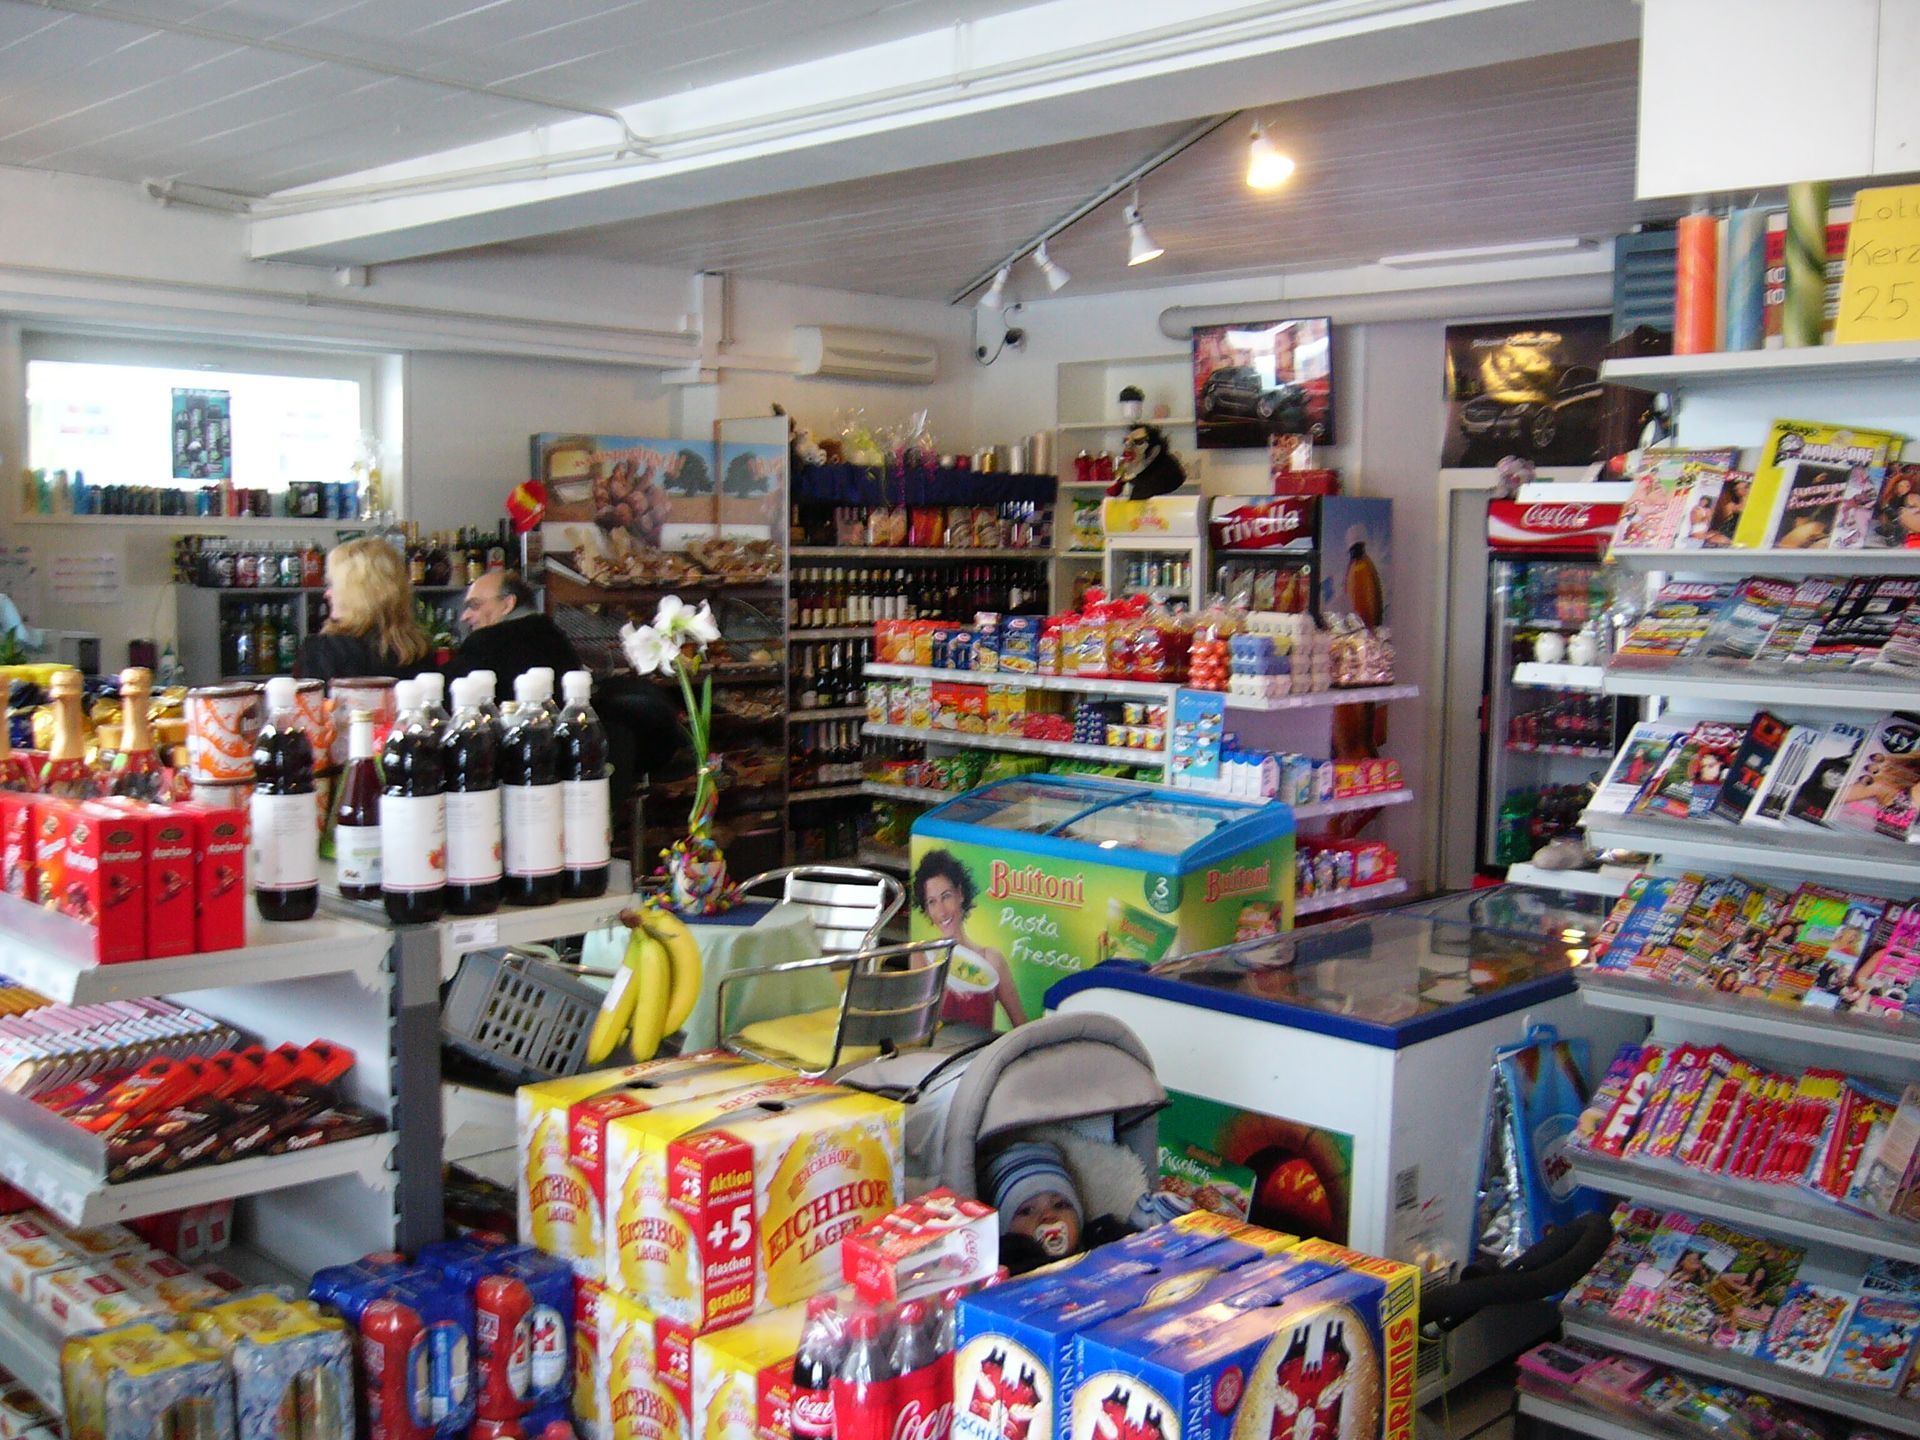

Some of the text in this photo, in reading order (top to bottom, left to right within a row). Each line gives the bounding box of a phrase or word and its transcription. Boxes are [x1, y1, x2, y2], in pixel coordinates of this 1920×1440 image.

[1855, 198, 1920, 223] Lot
[1219, 504, 1301, 548] rivella
[986, 857, 1085, 905] Buitoni
[1153, 876, 1171, 902] 3
[1203, 859, 1271, 905] Buitoni
[1000, 906, 1061, 939] Pasta
[1010, 934, 1082, 972] Fresca
[708, 1169, 753, 1195] Aktion
[706, 1203, 753, 1251] +5
[767, 1178, 890, 1269] EICHHOF
[799, 1214, 865, 1264] LAGER
[707, 1255, 752, 1280] Flaschen
[708, 1283, 752, 1320] gratis!
[1060, 1341, 1075, 1440] ORIGINAL
